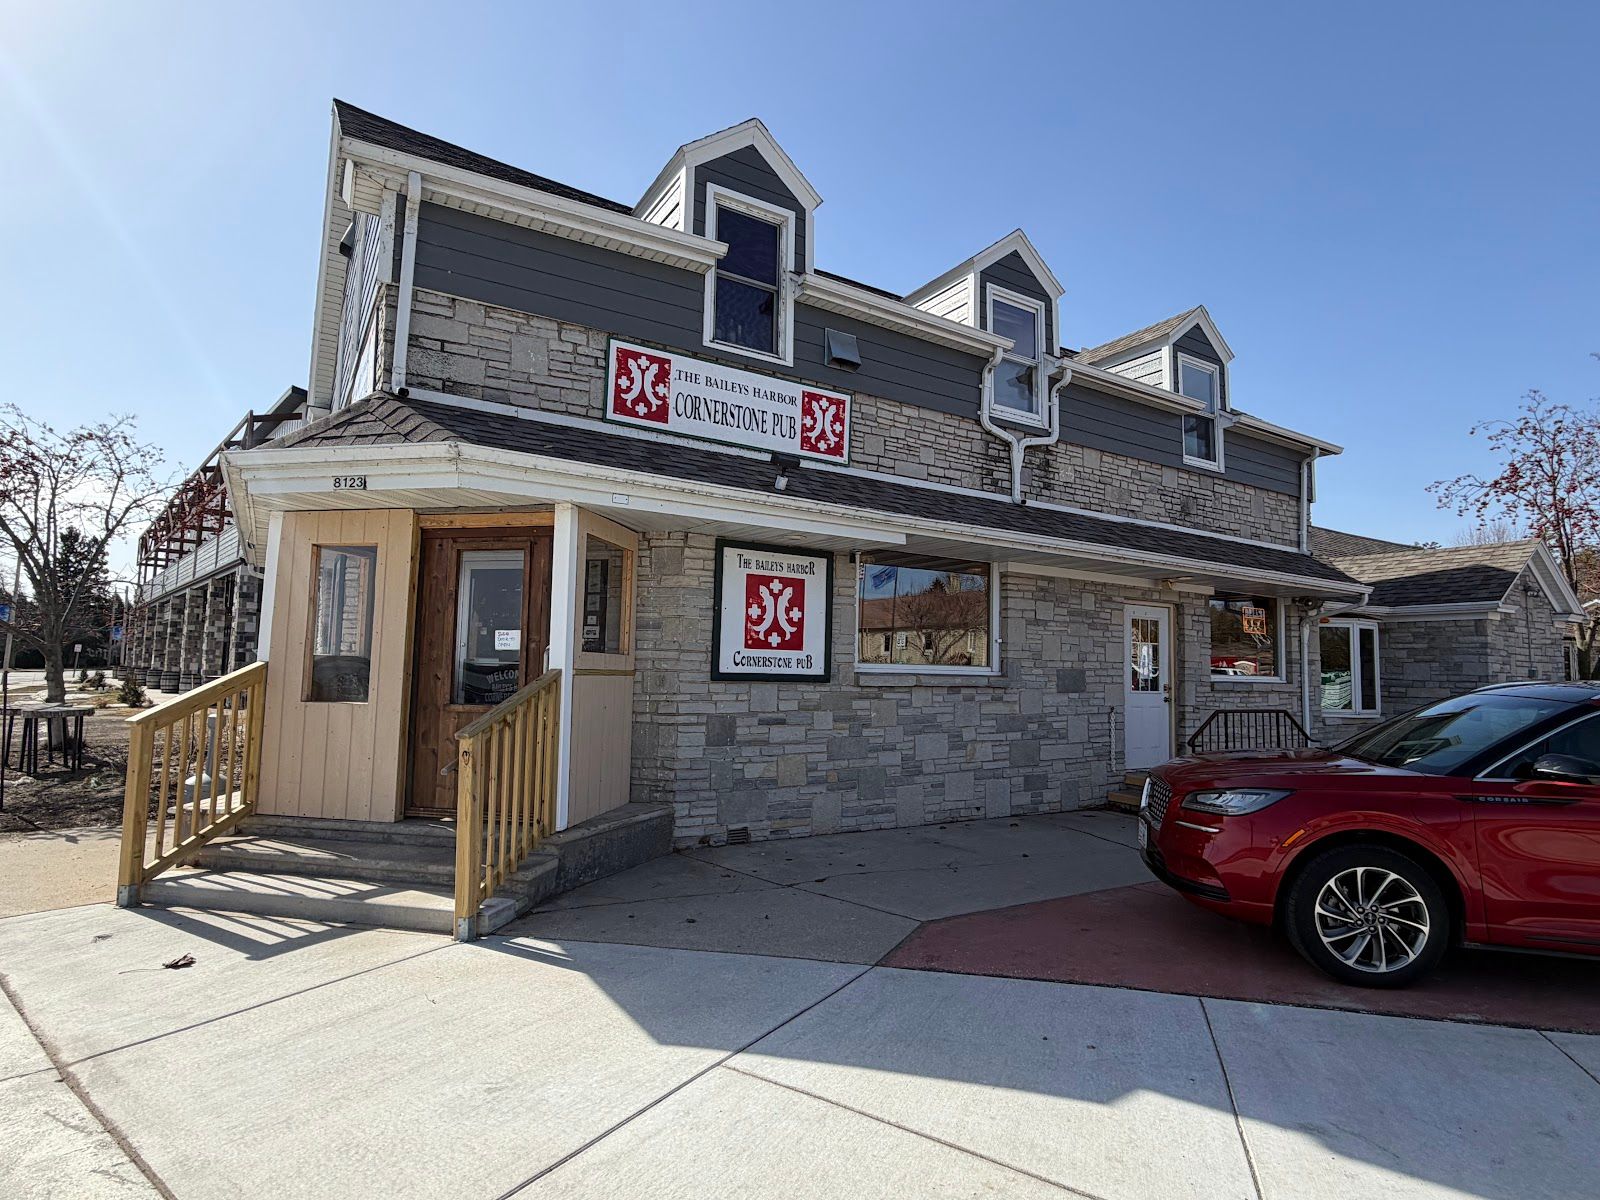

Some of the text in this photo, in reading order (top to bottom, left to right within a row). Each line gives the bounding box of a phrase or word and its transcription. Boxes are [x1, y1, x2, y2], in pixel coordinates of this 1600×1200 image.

[676, 369, 798, 407] THE BAILEYS HARBOR
[675, 391, 797, 440] CORNERSTONE PUB
[333, 476, 363, 488] 8123
[737, 553, 752, 569] THE
[786, 561, 815, 575] HARBOR
[733, 651, 813, 669] CORNERSTONE PUB
